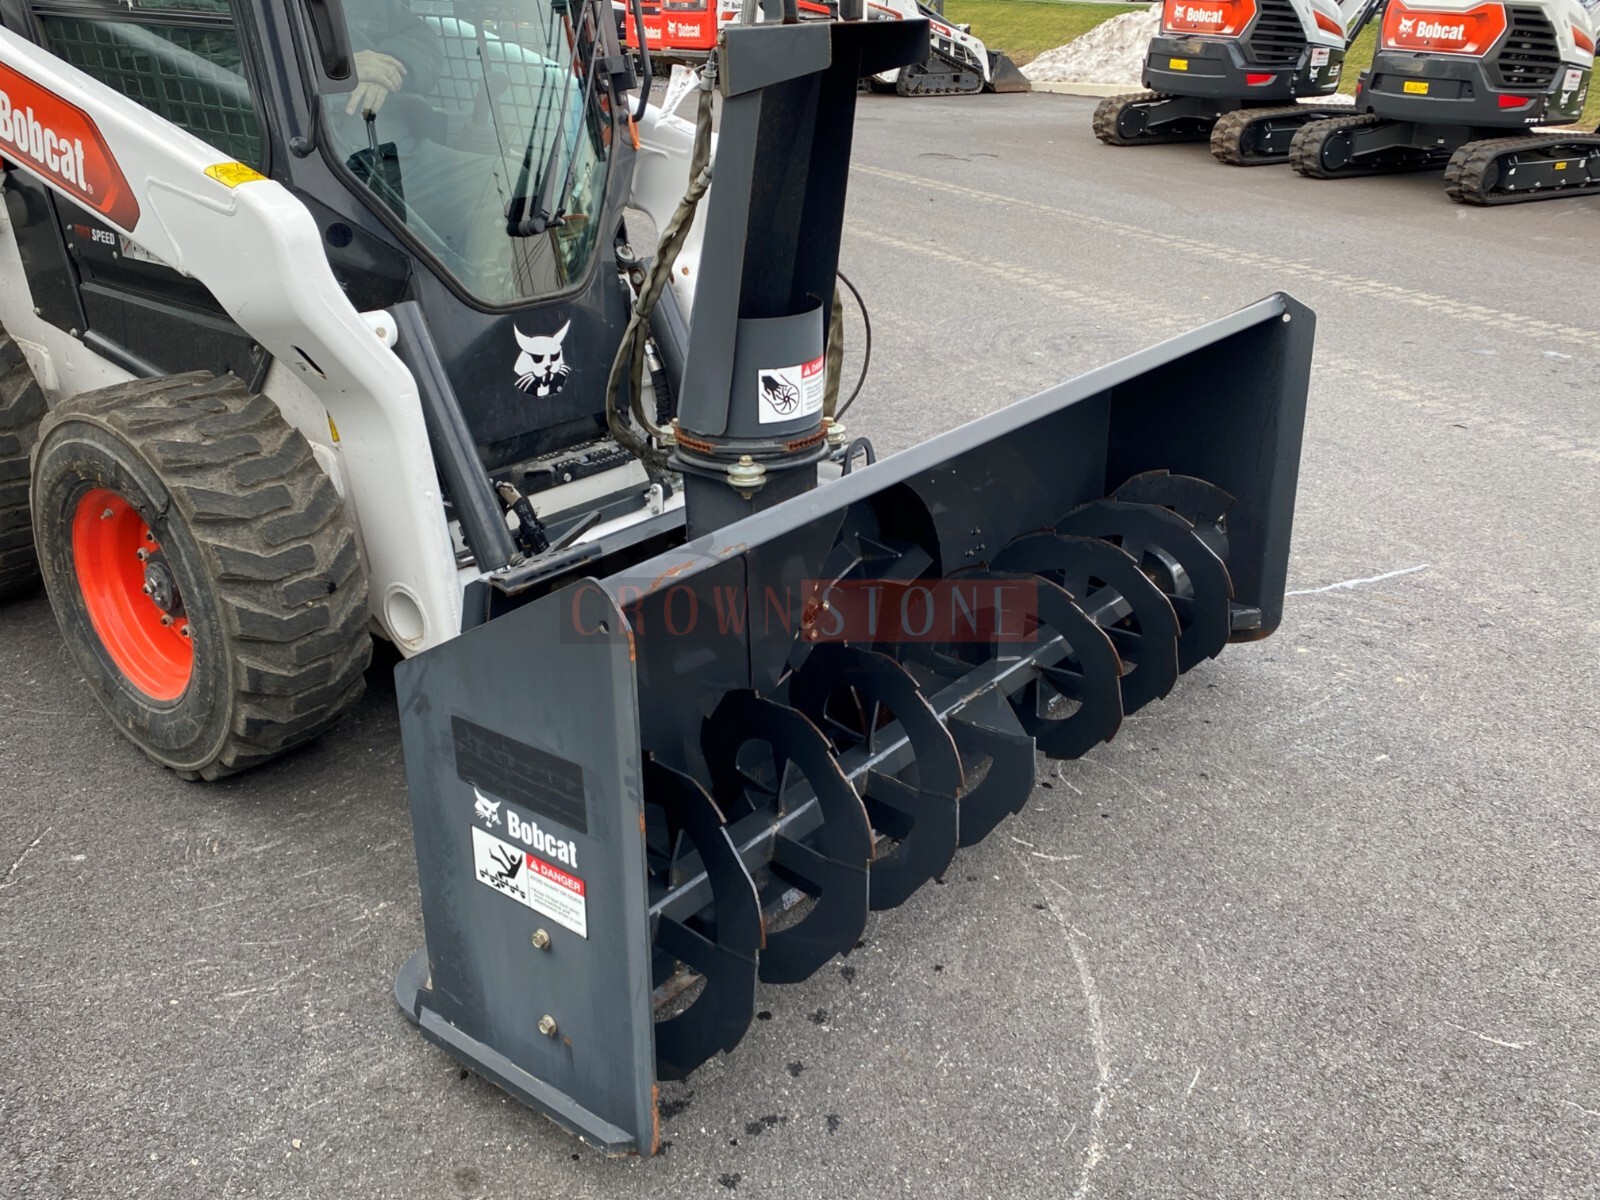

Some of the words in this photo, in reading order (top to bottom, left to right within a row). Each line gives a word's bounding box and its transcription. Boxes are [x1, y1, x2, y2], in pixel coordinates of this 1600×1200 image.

[1186, 7, 1224, 24] Bobcat
[677, 23, 700, 38] Bobcat
[1416, 21, 1465, 40] Bobcat
[0, 90, 88, 192] Bobcat
[91, 228, 115, 245] SPEED
[507, 810, 577, 869] Bobcat
[540, 865, 581, 893] DANGER
